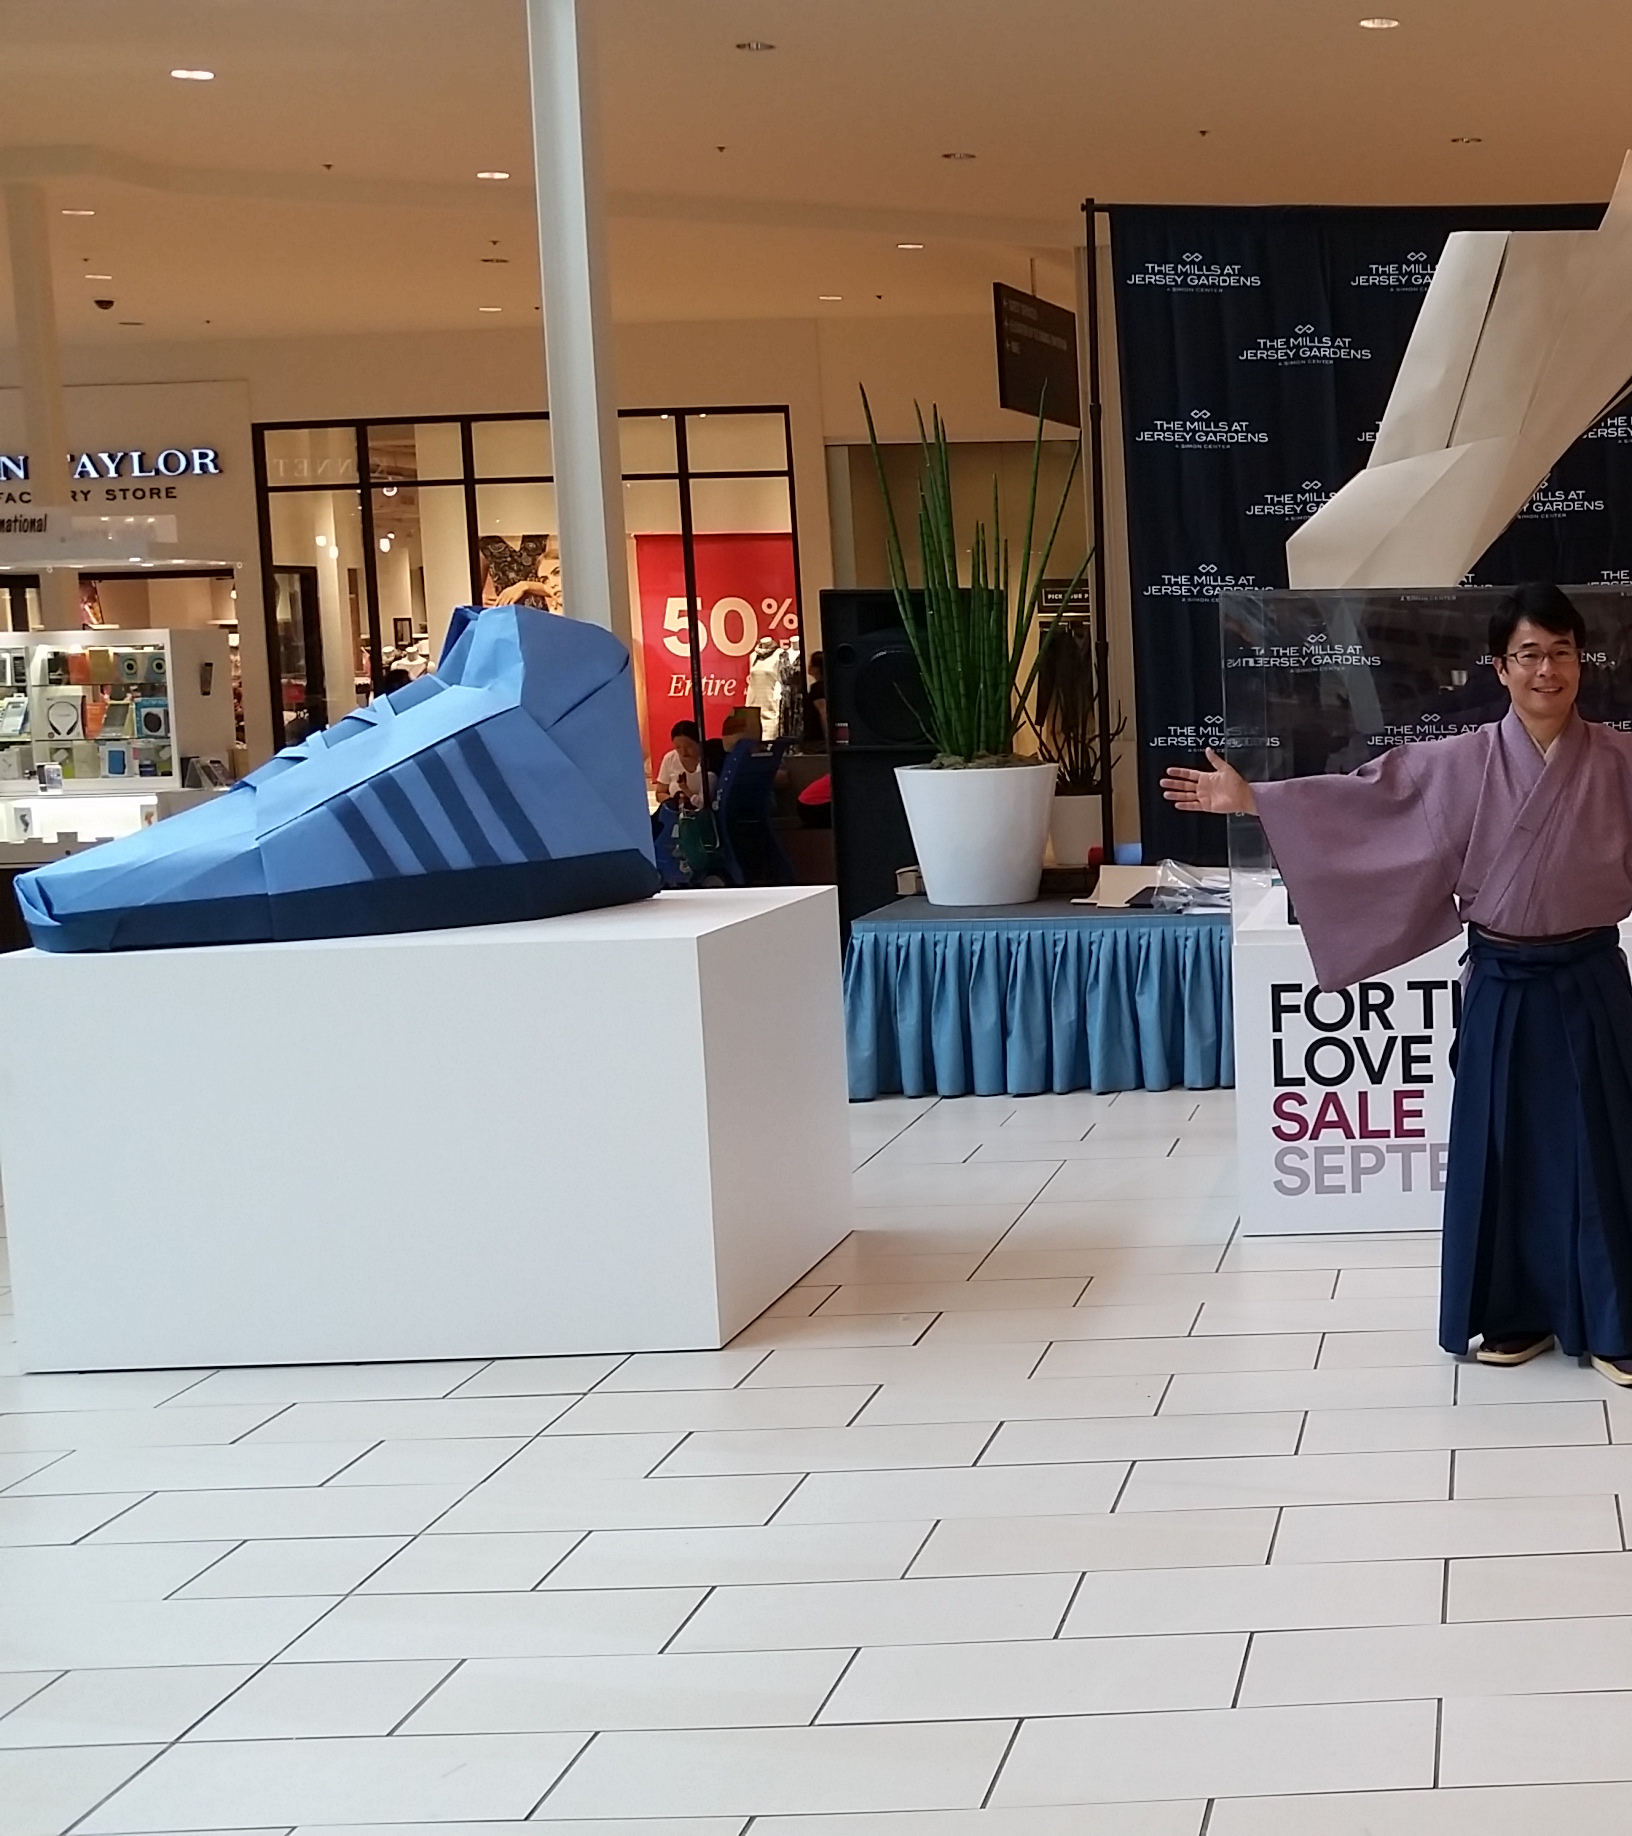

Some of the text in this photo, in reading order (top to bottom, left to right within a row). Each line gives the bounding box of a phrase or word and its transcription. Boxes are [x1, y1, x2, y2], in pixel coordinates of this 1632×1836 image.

[1145, 264, 1241, 274] THE MILLS AT
[1369, 264, 1437, 274] THE MILL
[1127, 274, 1261, 286] JERSEY GARDENS
[1350, 275, 1408, 285] JERSEY
[1257, 337, 1351, 348] THE MILLS AT
[1239, 348, 1371, 360] JERSEY GARDENS
[1154, 421, 1249, 431] THE MILLS AT
[1601, 417, 1627, 426] HE
[1136, 432, 1268, 442] JERSEY GARDENS
[67, 449, 221, 479] AYLOR
[106, 487, 177, 501] STORE
[1264, 494, 1294, 504] THE
[1568, 490, 1585, 499] AT
[1246, 504, 1303, 515] JERSEY
[1533, 501, 1604, 512] GARDENS
[1601, 570, 1629, 579] THE
[1162, 575, 1255, 585] THE MILLS AT
[1143, 586, 1200, 595] JERSEY
[663, 597, 798, 657] 50%
[1270, 645, 1362, 656] THE MILLS AT
[1312, 655, 1381, 666] GARDENS
[1168, 727, 1196, 735] THE
[1385, 725, 1478, 734] THE MILLS AT
[1150, 737, 1205, 746] JERSEY
[1271, 981, 1395, 1032] FOR
[1272, 1034, 1434, 1087] LOVE
[1271, 1089, 1426, 1142] SALE
